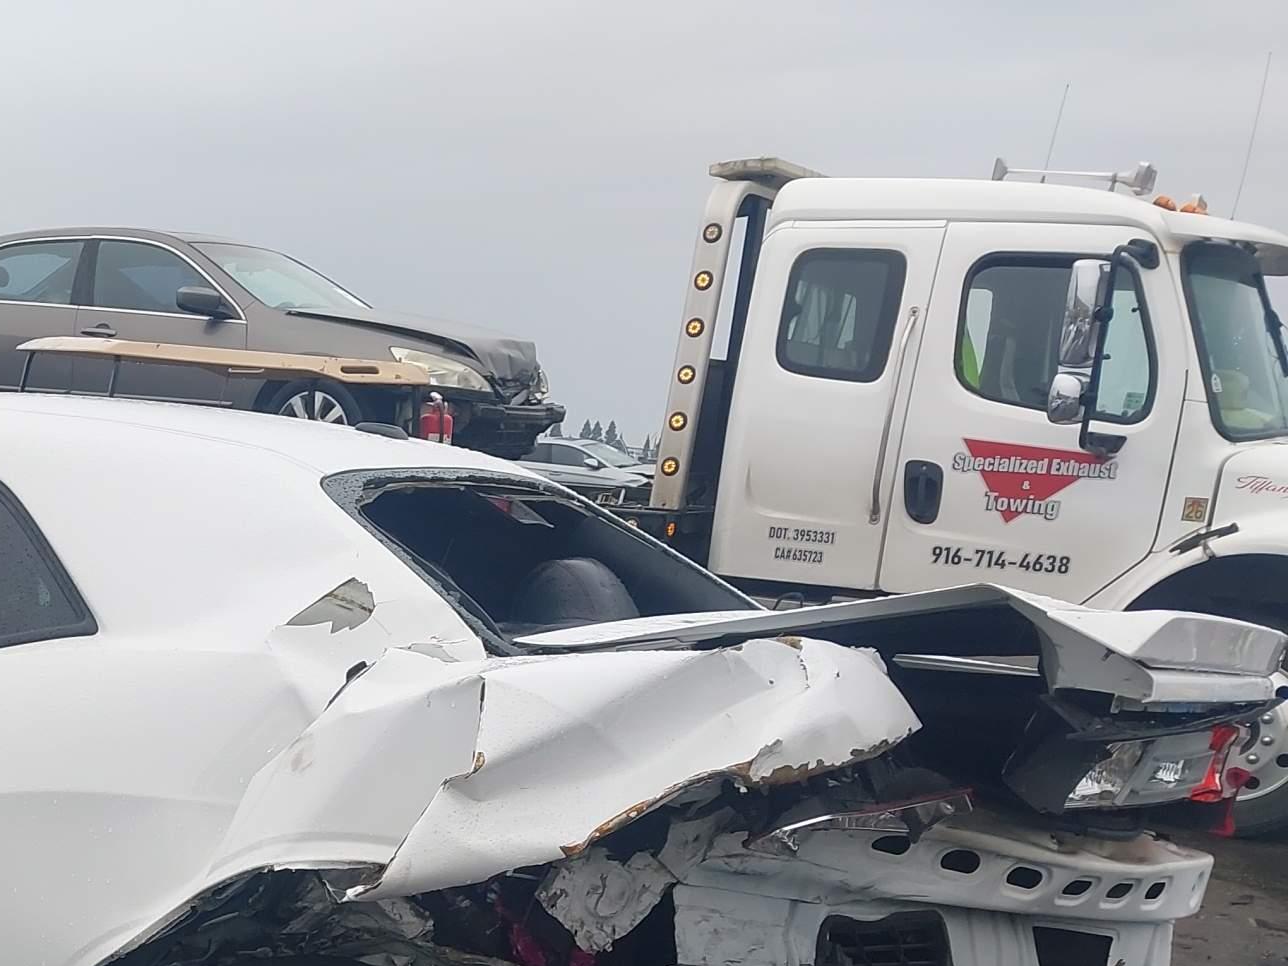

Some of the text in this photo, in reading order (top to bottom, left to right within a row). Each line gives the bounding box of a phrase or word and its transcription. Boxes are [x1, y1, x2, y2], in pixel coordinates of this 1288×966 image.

[953, 452, 1119, 479] Specialized Exhaust
[1021, 480, 1031, 490] &
[985, 491, 1062, 521] Towing
[793, 528, 835, 544] 3953331
[931, 545, 1071, 574] 916-714-4638
